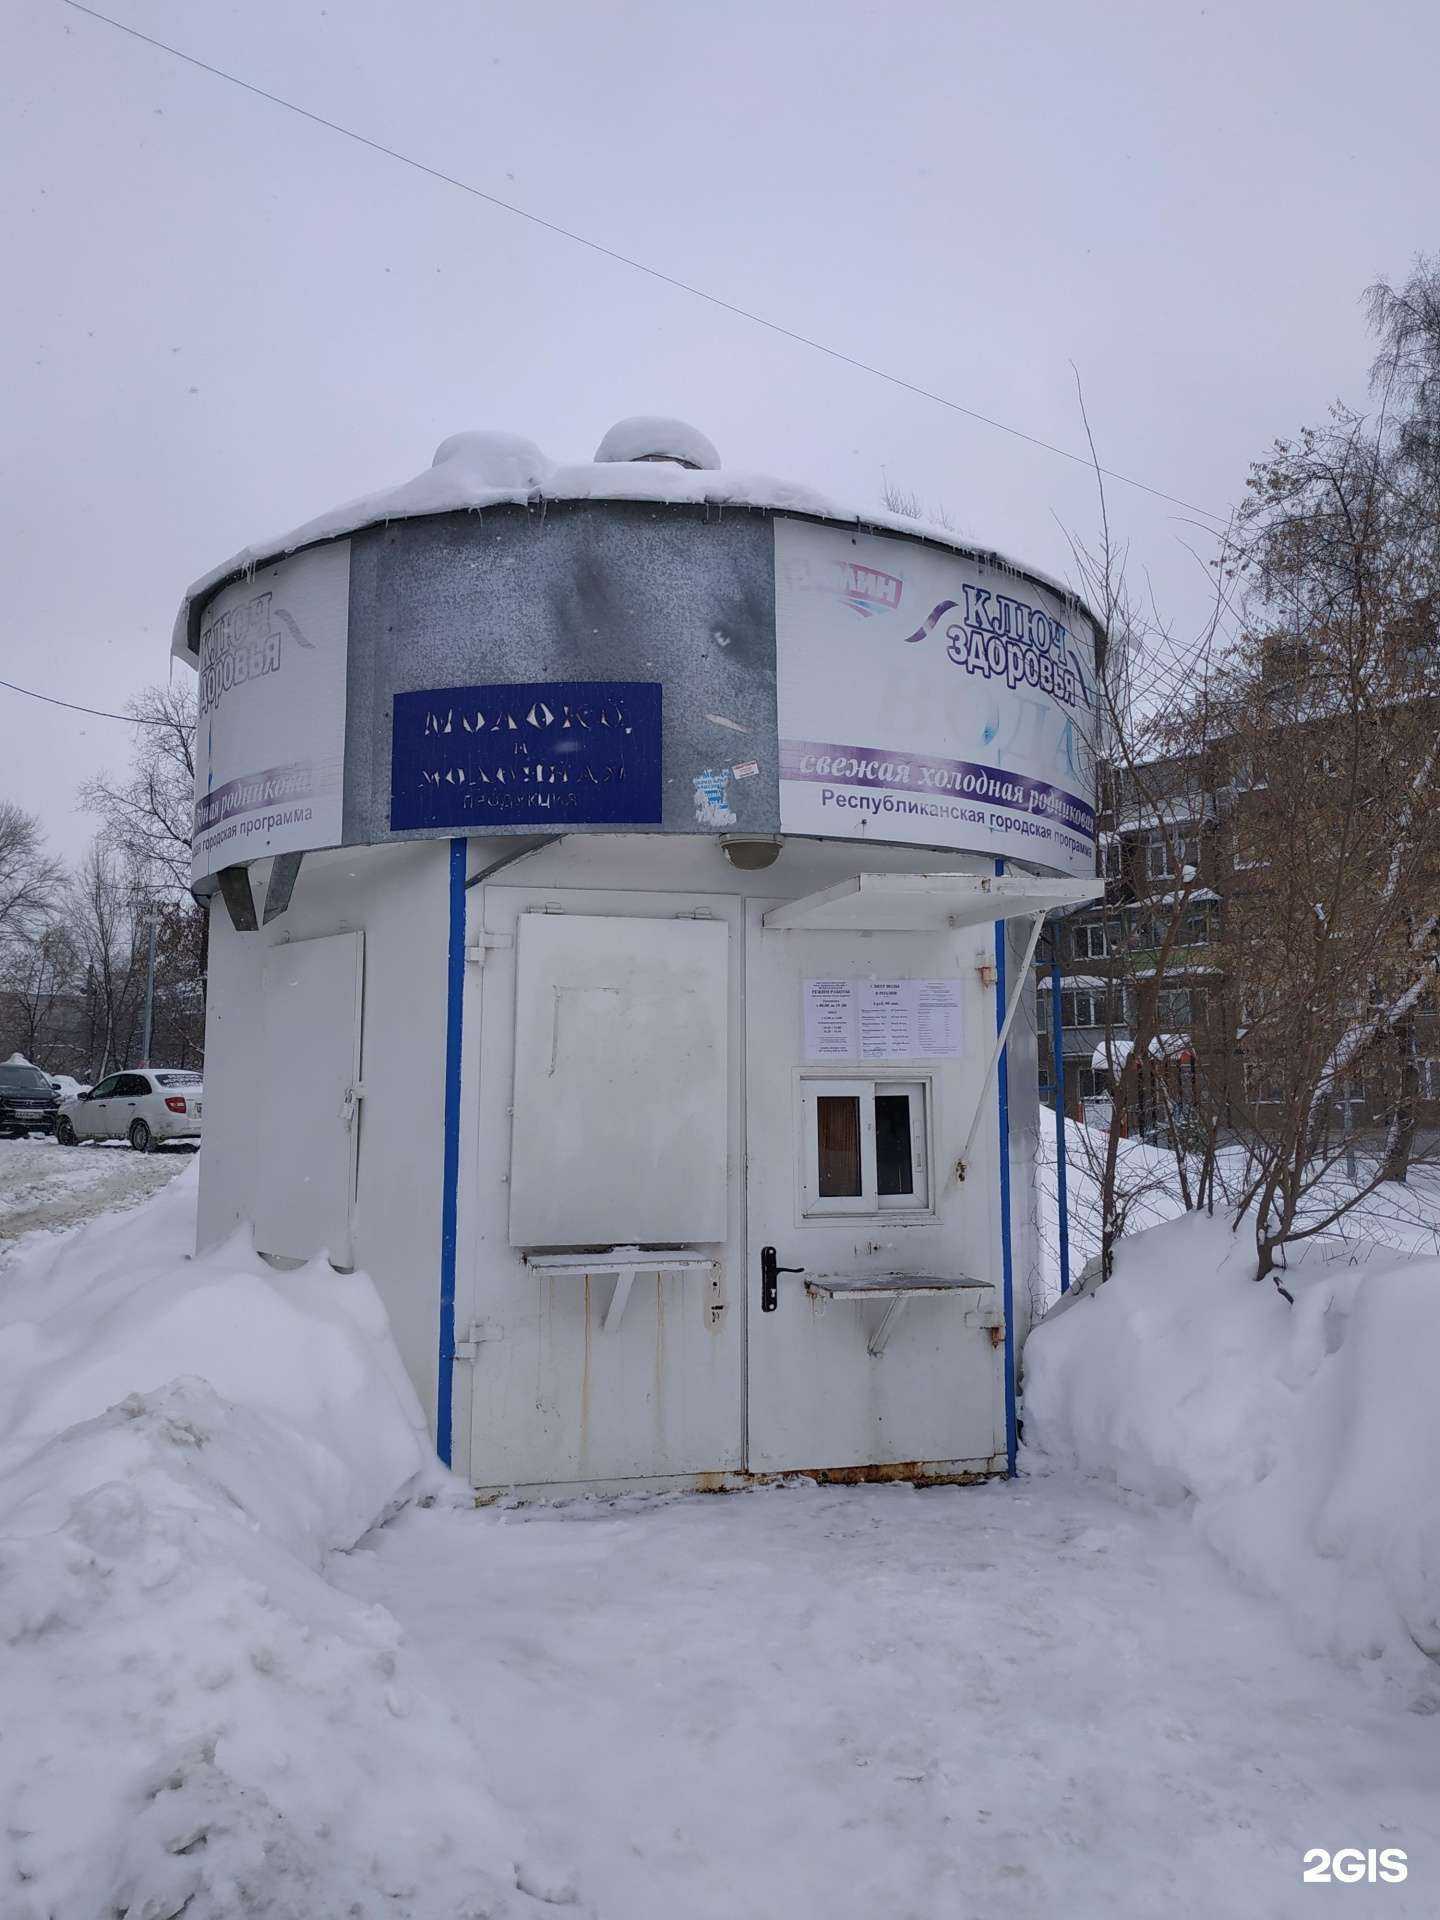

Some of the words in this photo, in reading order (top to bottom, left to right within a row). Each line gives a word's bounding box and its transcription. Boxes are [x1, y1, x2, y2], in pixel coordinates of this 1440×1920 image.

[962, 583, 1067, 666] КЛЮЧ
[800, 753, 911, 782] свежая
[919, 766, 1024, 804] холодная
[239, 807, 313, 837] программа
[821, 788, 985, 826] Республиканская
[990, 811, 1052, 840] городская
